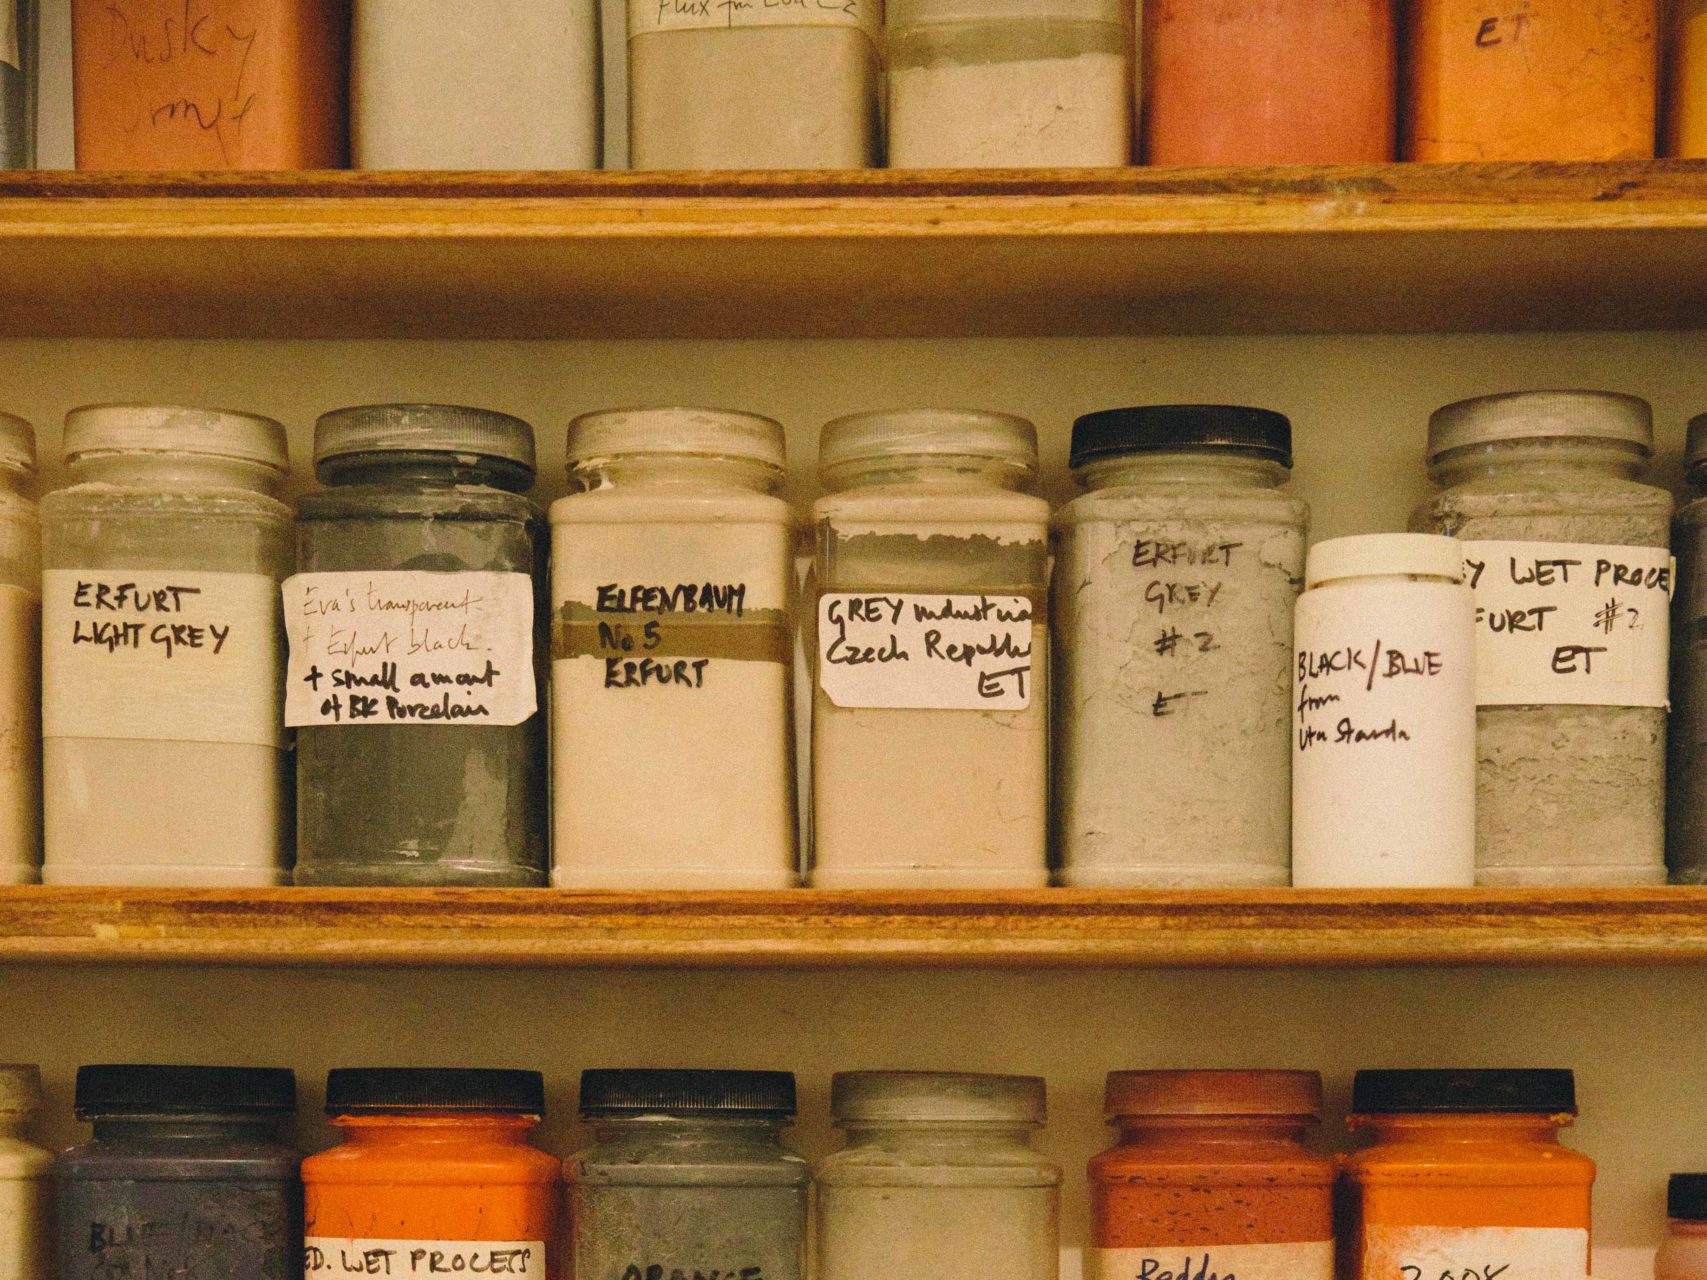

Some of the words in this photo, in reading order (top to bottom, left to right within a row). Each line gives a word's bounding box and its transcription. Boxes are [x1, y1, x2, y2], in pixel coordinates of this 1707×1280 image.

[1132, 540, 1243, 568] ERFURT
[1462, 556, 1485, 591] Y
[1510, 556, 1582, 586] WET
[73, 582, 201, 613] ERFURT
[597, 583, 746, 616] ELFENBAUM
[1144, 581, 1222, 614] GREY
[828, 597, 905, 636] GREY
[72, 621, 145, 653] LIGHT
[150, 624, 230, 658] GREY
[640, 620, 662, 649] 5
[826, 634, 909, 666] Czech
[604, 657, 709, 689] ERFURT
[1298, 639, 1444, 691] BLACK/BLUE
[1550, 644, 1608, 675] ET
[303, 664, 323, 692] +
[331, 661, 401, 693] small
[977, 665, 1032, 700] ET
[320, 693, 343, 722] of
[386, 690, 490, 720] Porcelain
[1152, 690, 1208, 718] ET
[341, 1248, 397, 1276] WET
